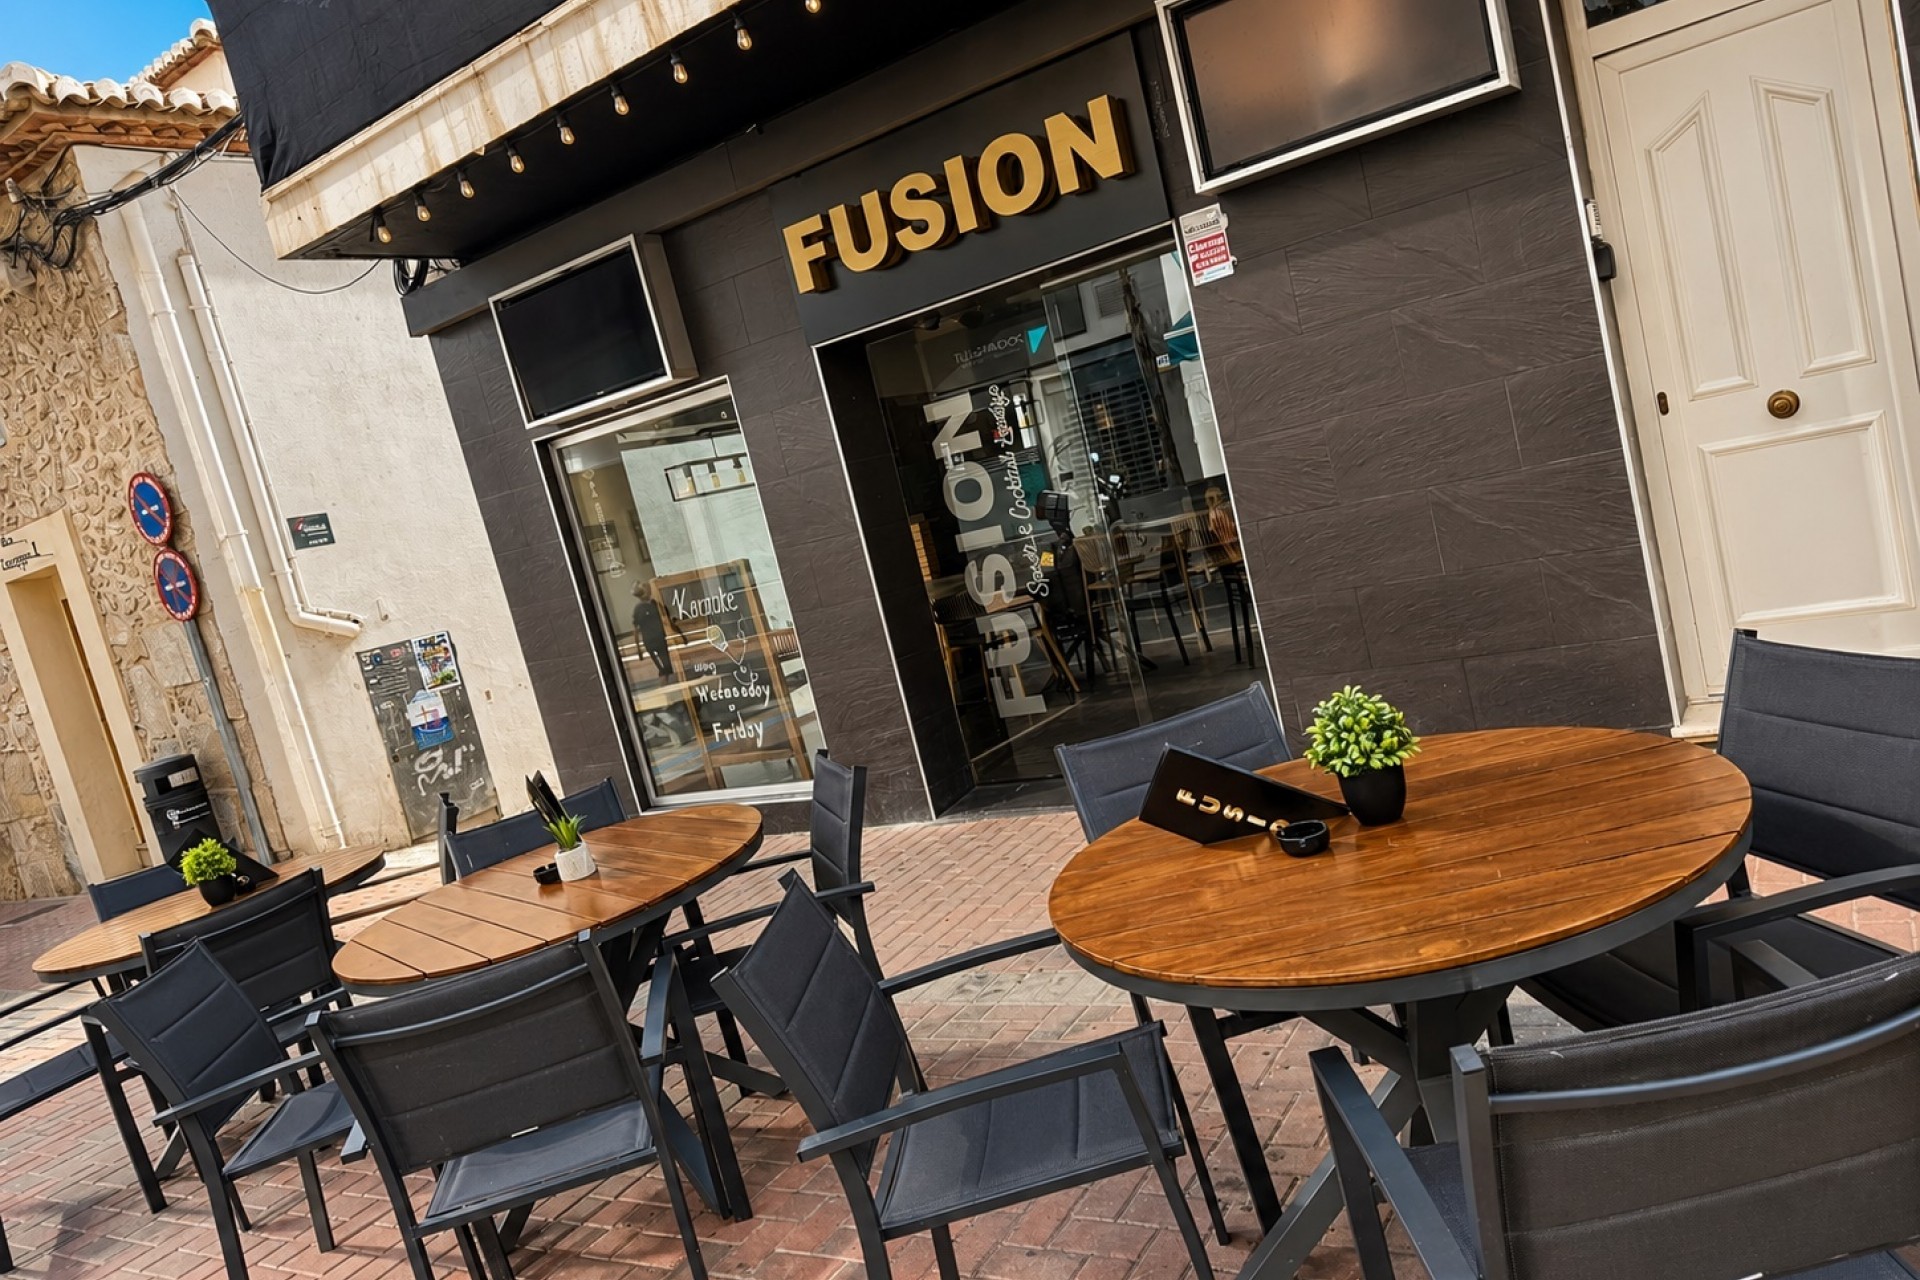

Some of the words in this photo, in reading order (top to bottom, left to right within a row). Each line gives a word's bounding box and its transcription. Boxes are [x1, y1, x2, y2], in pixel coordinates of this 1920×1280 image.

[782, 94, 1128, 294] FUSION
[923, 392, 1048, 718] FUSION
[711, 711, 764, 748] Friday
[1176, 788, 1290, 833] FUSIO
